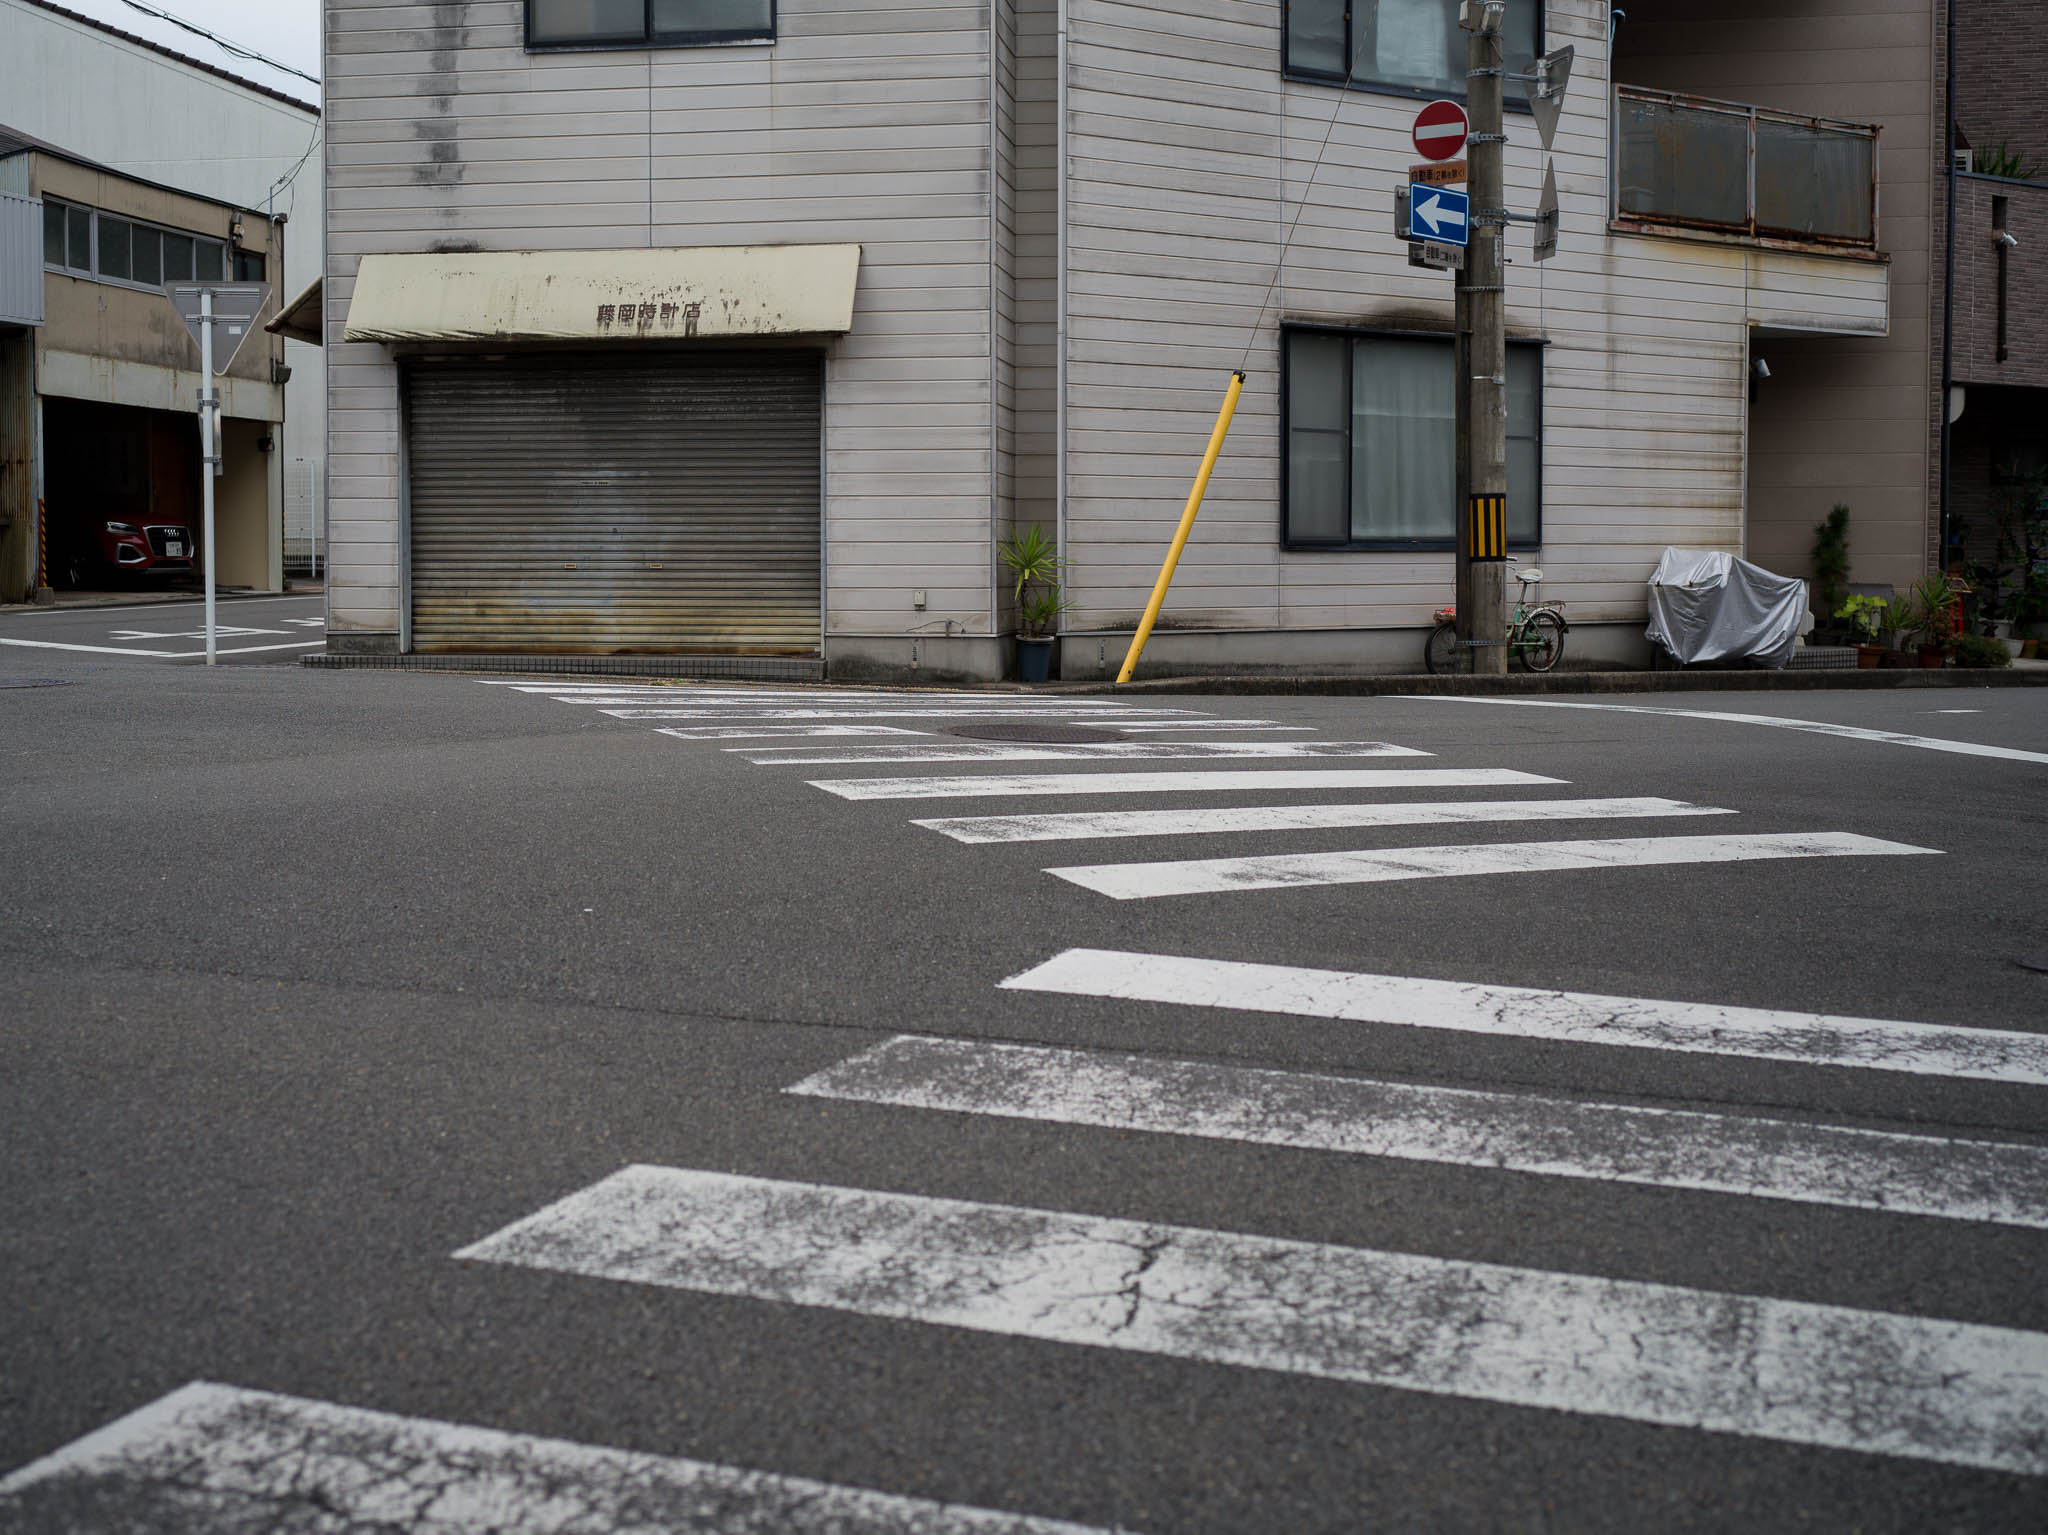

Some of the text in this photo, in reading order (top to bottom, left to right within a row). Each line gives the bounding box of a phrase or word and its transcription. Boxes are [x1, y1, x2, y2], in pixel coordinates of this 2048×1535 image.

[597, 303, 701, 321] 藤岡時計店
